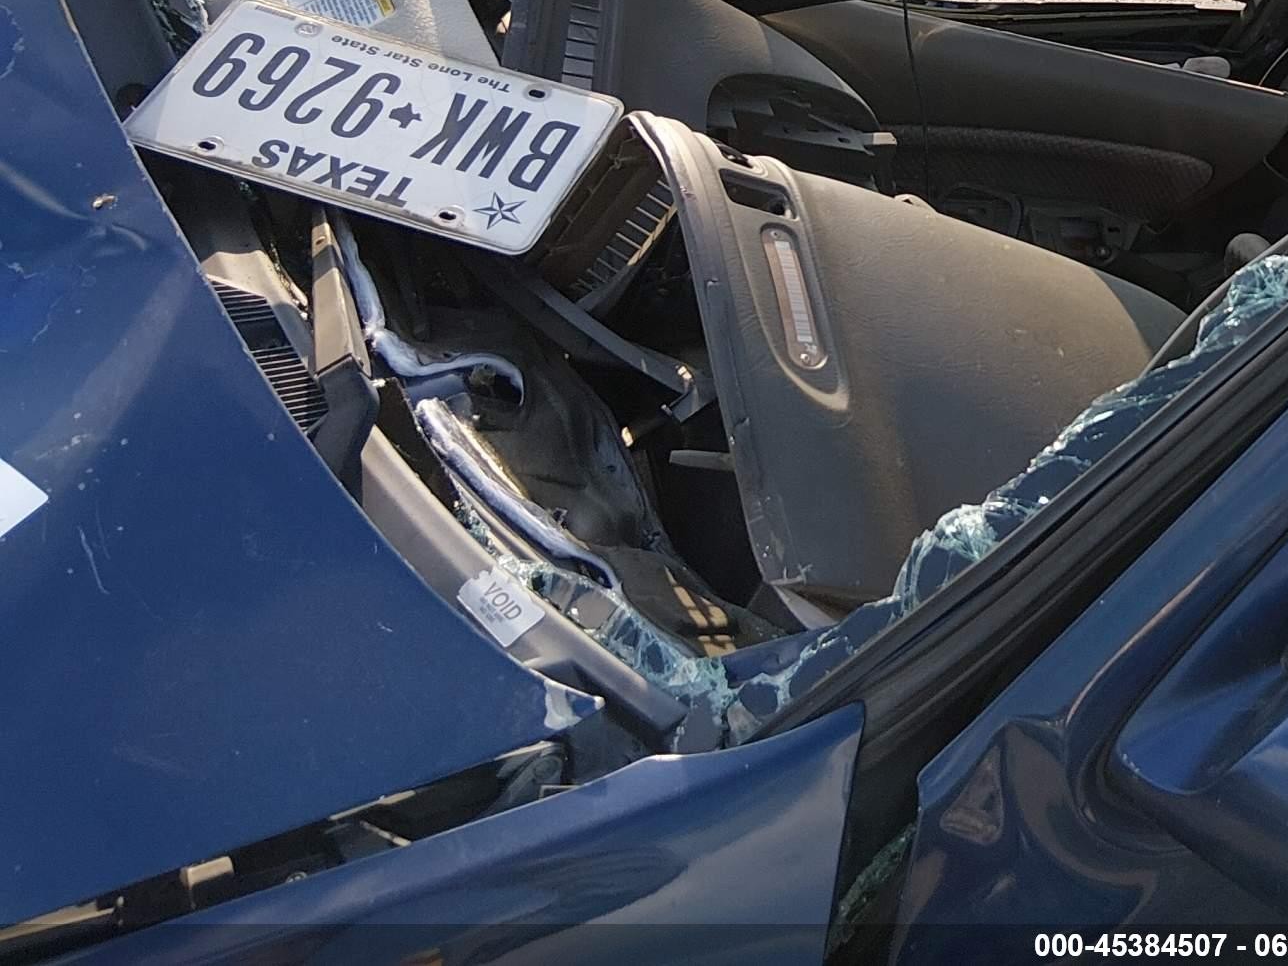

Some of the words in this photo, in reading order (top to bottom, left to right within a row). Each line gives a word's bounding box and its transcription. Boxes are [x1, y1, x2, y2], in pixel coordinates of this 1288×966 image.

[331, 35, 380, 56] State
[384, 49, 423, 69] Star
[192, 32, 402, 139] 9269
[428, 62, 474, 82] Lone
[477, 76, 511, 93] The
[410, 92, 580, 192] BWK
[251, 138, 413, 208] TEXAS
[484, 581, 523, 621] VOID
